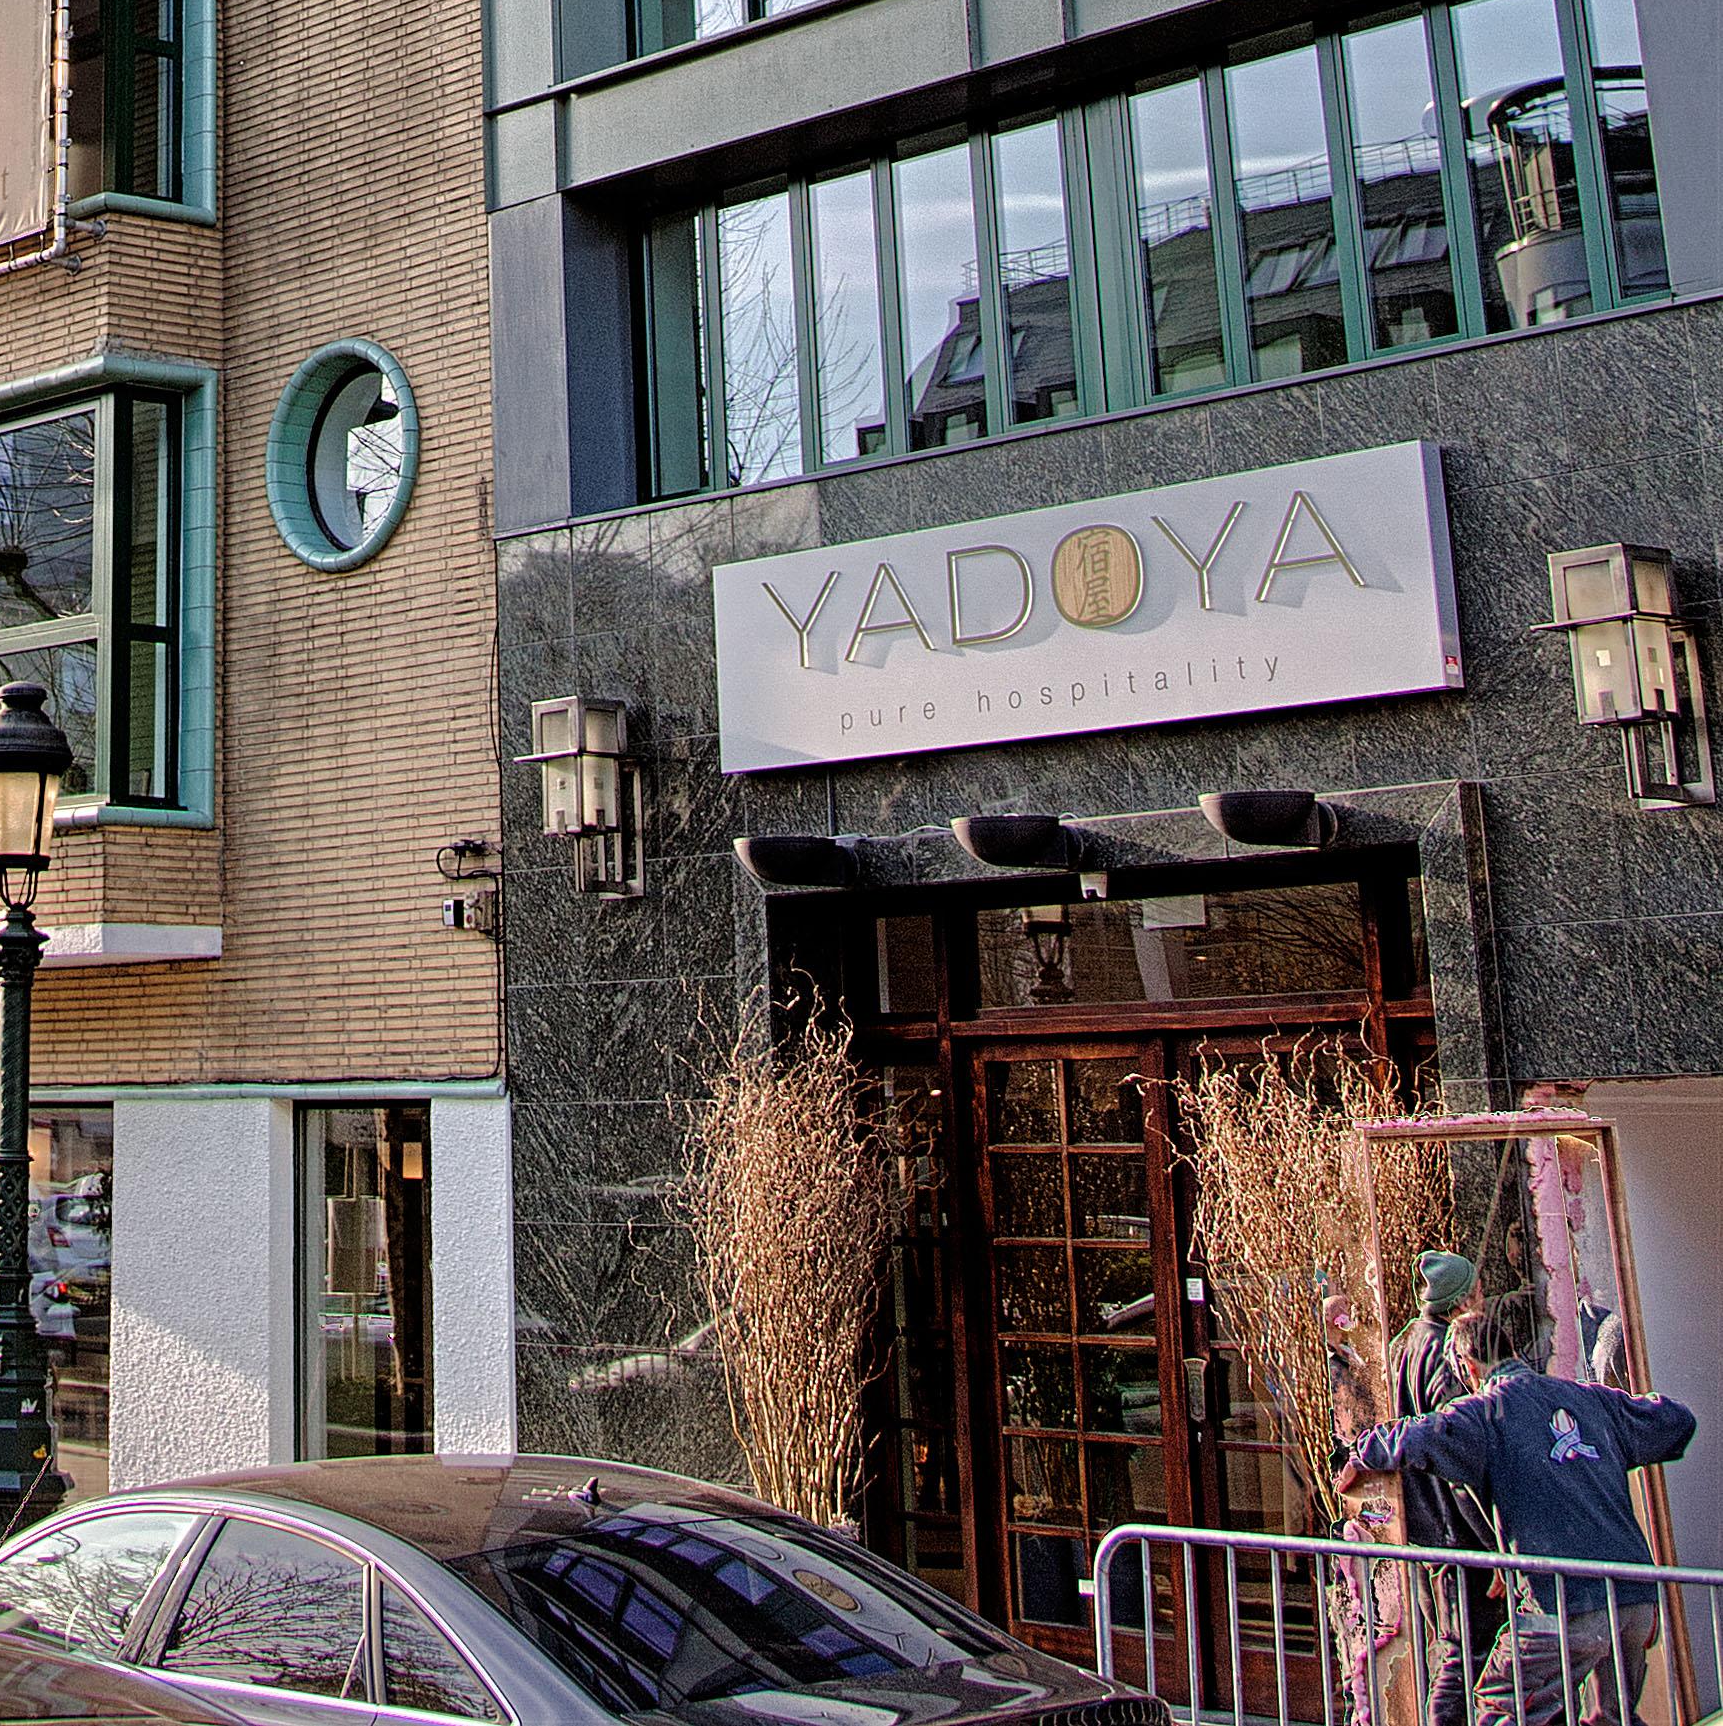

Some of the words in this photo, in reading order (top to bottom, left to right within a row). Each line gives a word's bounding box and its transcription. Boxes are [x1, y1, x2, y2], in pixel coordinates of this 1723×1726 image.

[760, 489, 1367, 670] YADOYA
[839, 697, 936, 736] pure
[977, 654, 1279, 714] hospitality
